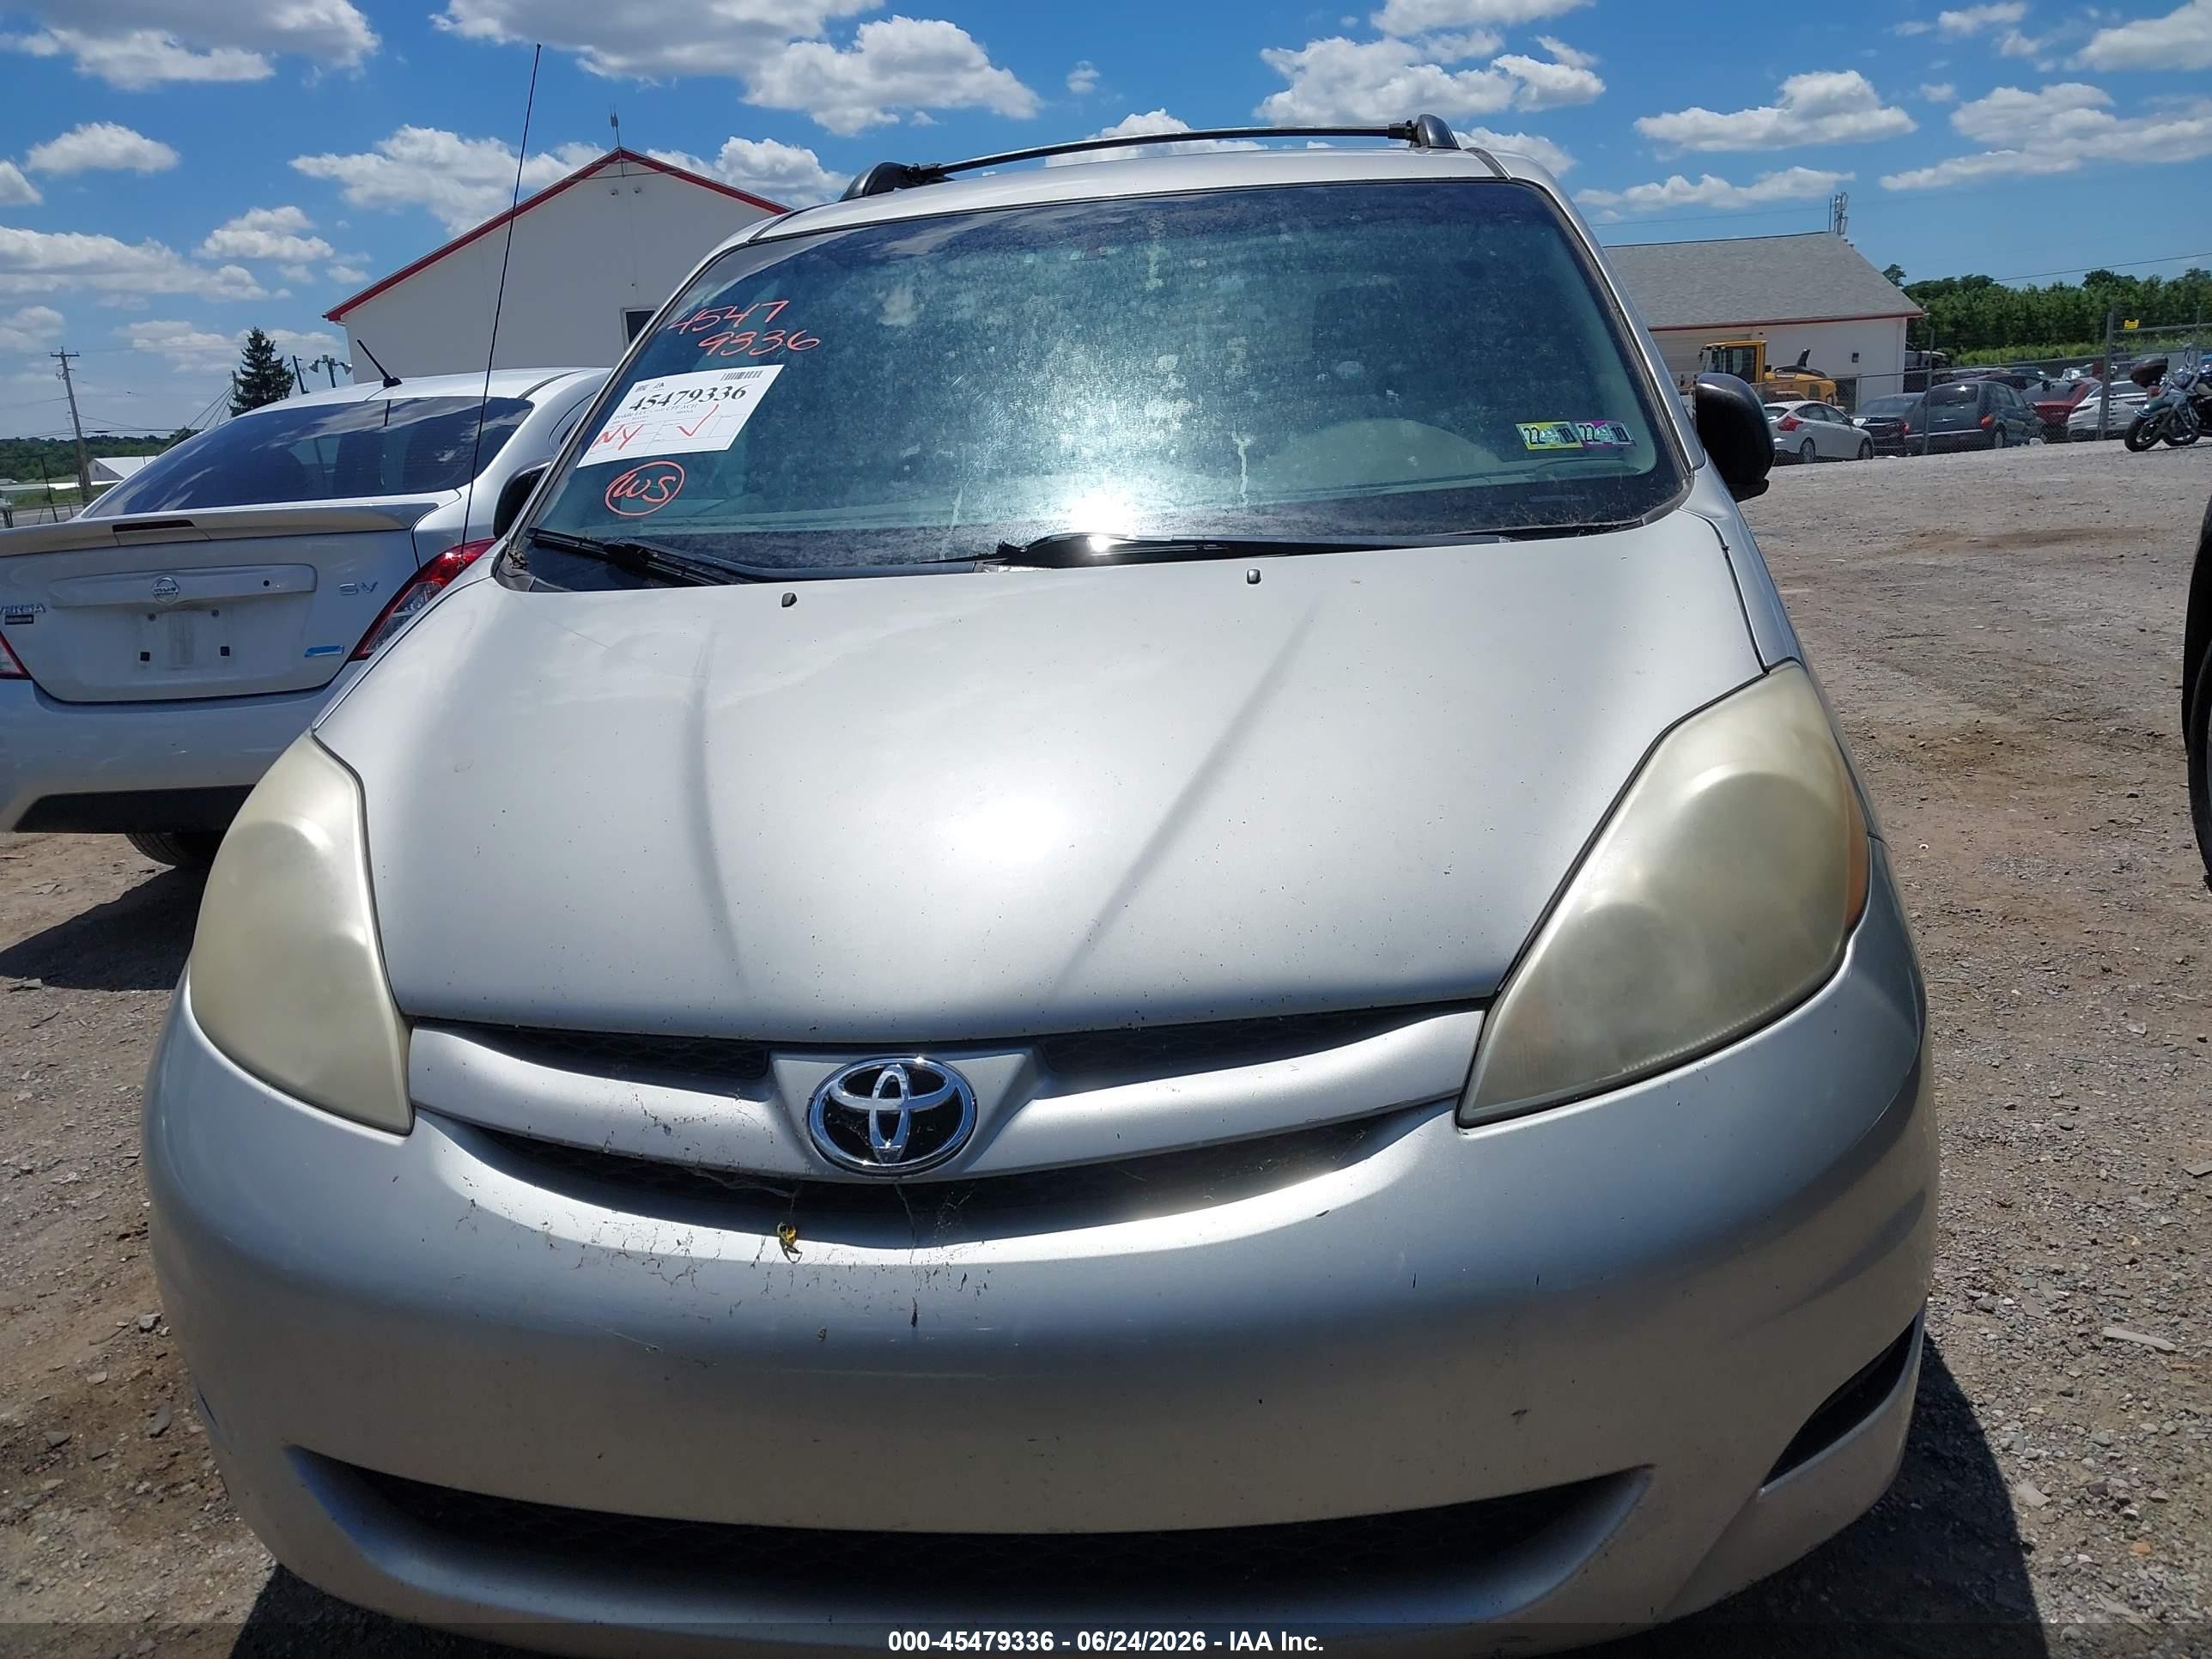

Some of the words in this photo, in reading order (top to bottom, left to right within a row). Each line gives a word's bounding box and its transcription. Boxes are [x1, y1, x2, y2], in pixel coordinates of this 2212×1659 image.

[667, 300, 790, 335] 4547
[698, 329, 821, 356] 9336
[629, 384, 748, 411] 45479336
[338, 580, 379, 596] SV
